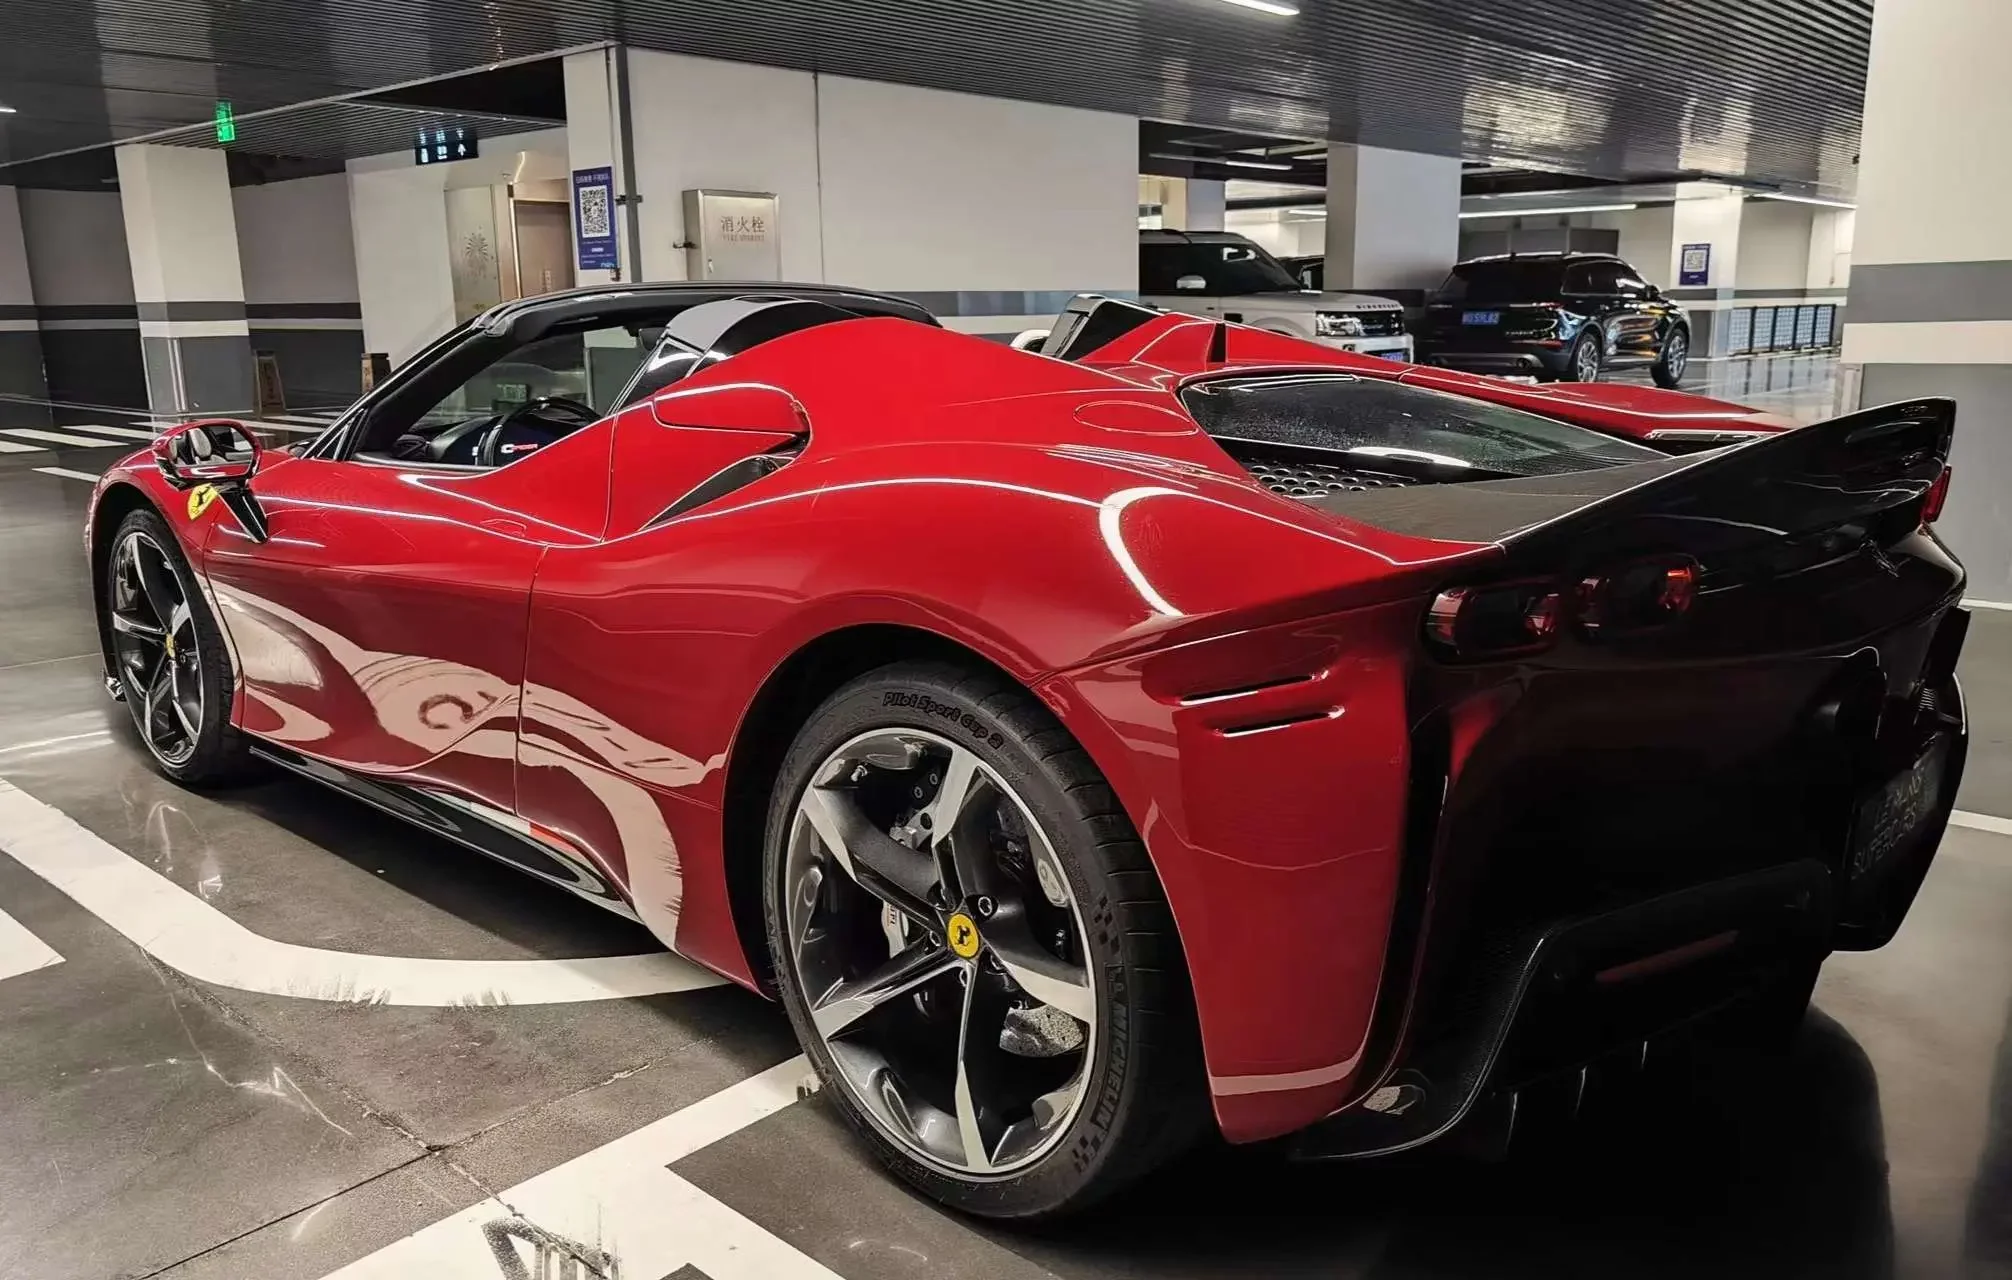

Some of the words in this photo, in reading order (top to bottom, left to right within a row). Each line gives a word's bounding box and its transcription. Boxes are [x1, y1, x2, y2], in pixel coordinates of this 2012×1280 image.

[721, 215, 766, 233] 消火栓
[883, 692, 918, 708] Pilot
[918, 695, 961, 722] Sport
[960, 714, 989, 739] Cup
[987, 733, 1004, 750] 2
[1095, 1001, 1129, 1131] MICHELIN
